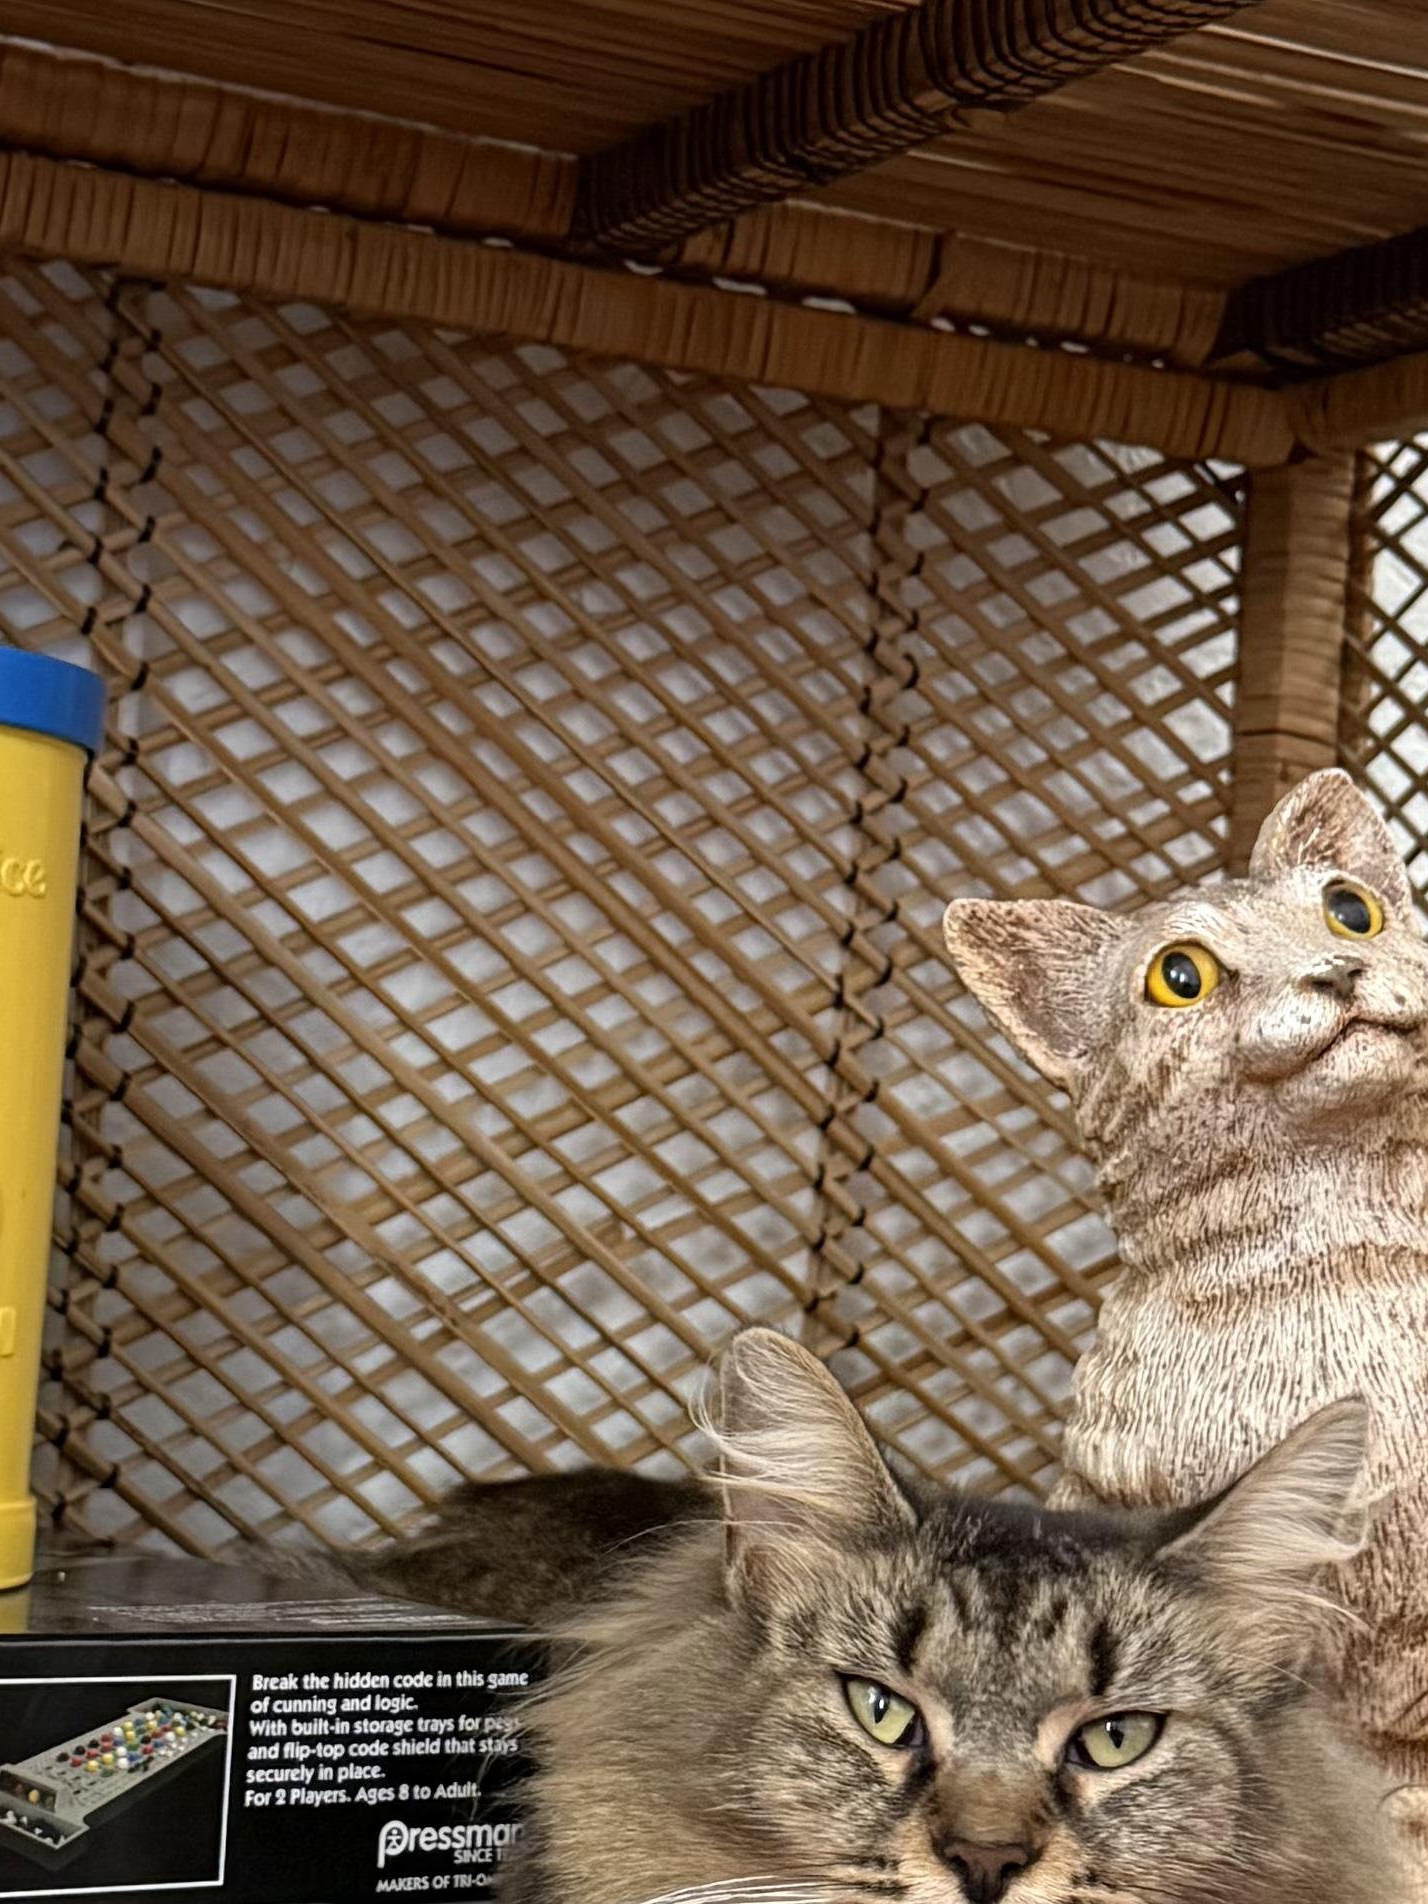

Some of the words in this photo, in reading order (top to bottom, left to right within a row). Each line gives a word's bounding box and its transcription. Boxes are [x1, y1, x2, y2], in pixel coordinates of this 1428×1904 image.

[252, 1674, 298, 1691] Break
[302, 1673, 330, 1690] the
[334, 1673, 390, 1689] hidden
[393, 1672, 433, 1688] code
[436, 1671, 452, 1688] in
[456, 1670, 484, 1687] this
[487, 1672, 529, 1689] game
[250, 1697, 270, 1714] of
[273, 1696, 337, 1715] cunning
[341, 1695, 371, 1711] and
[375, 1694, 418, 1712] logic.
[249, 1719, 287, 1736] With
[291, 1718, 350, 1735] built-in
[353, 1718, 413, 1737] storage
[417, 1716, 454, 1735] trays
[458, 1714, 479, 1731] for
[247, 1743, 279, 1760] and
[283, 1742, 345, 1760] flip-top
[349, 1741, 389, 1757] code
[392, 1739, 440, 1755] shield
[444, 1738, 476, 1754] that
[479, 1737, 518, 1755] stays
[246, 1764, 314, 1783] securely
[318, 1764, 333, 1780] in
[338, 1763, 385, 1782] place.
[244, 1789, 272, 1807] For
[275, 1789, 286, 1805] 2
[290, 1788, 351, 1807] Players.
[354, 1787, 395, 1805] Ages
[399, 1786, 409, 1800] 8
[413, 1785, 431, 1799] to
[434, 1781, 482, 1799] Adult.
[453, 1849, 493, 1864] SINCE
[376, 1876, 429, 1892] MAKERS
[432, 1875, 450, 1890] OF
